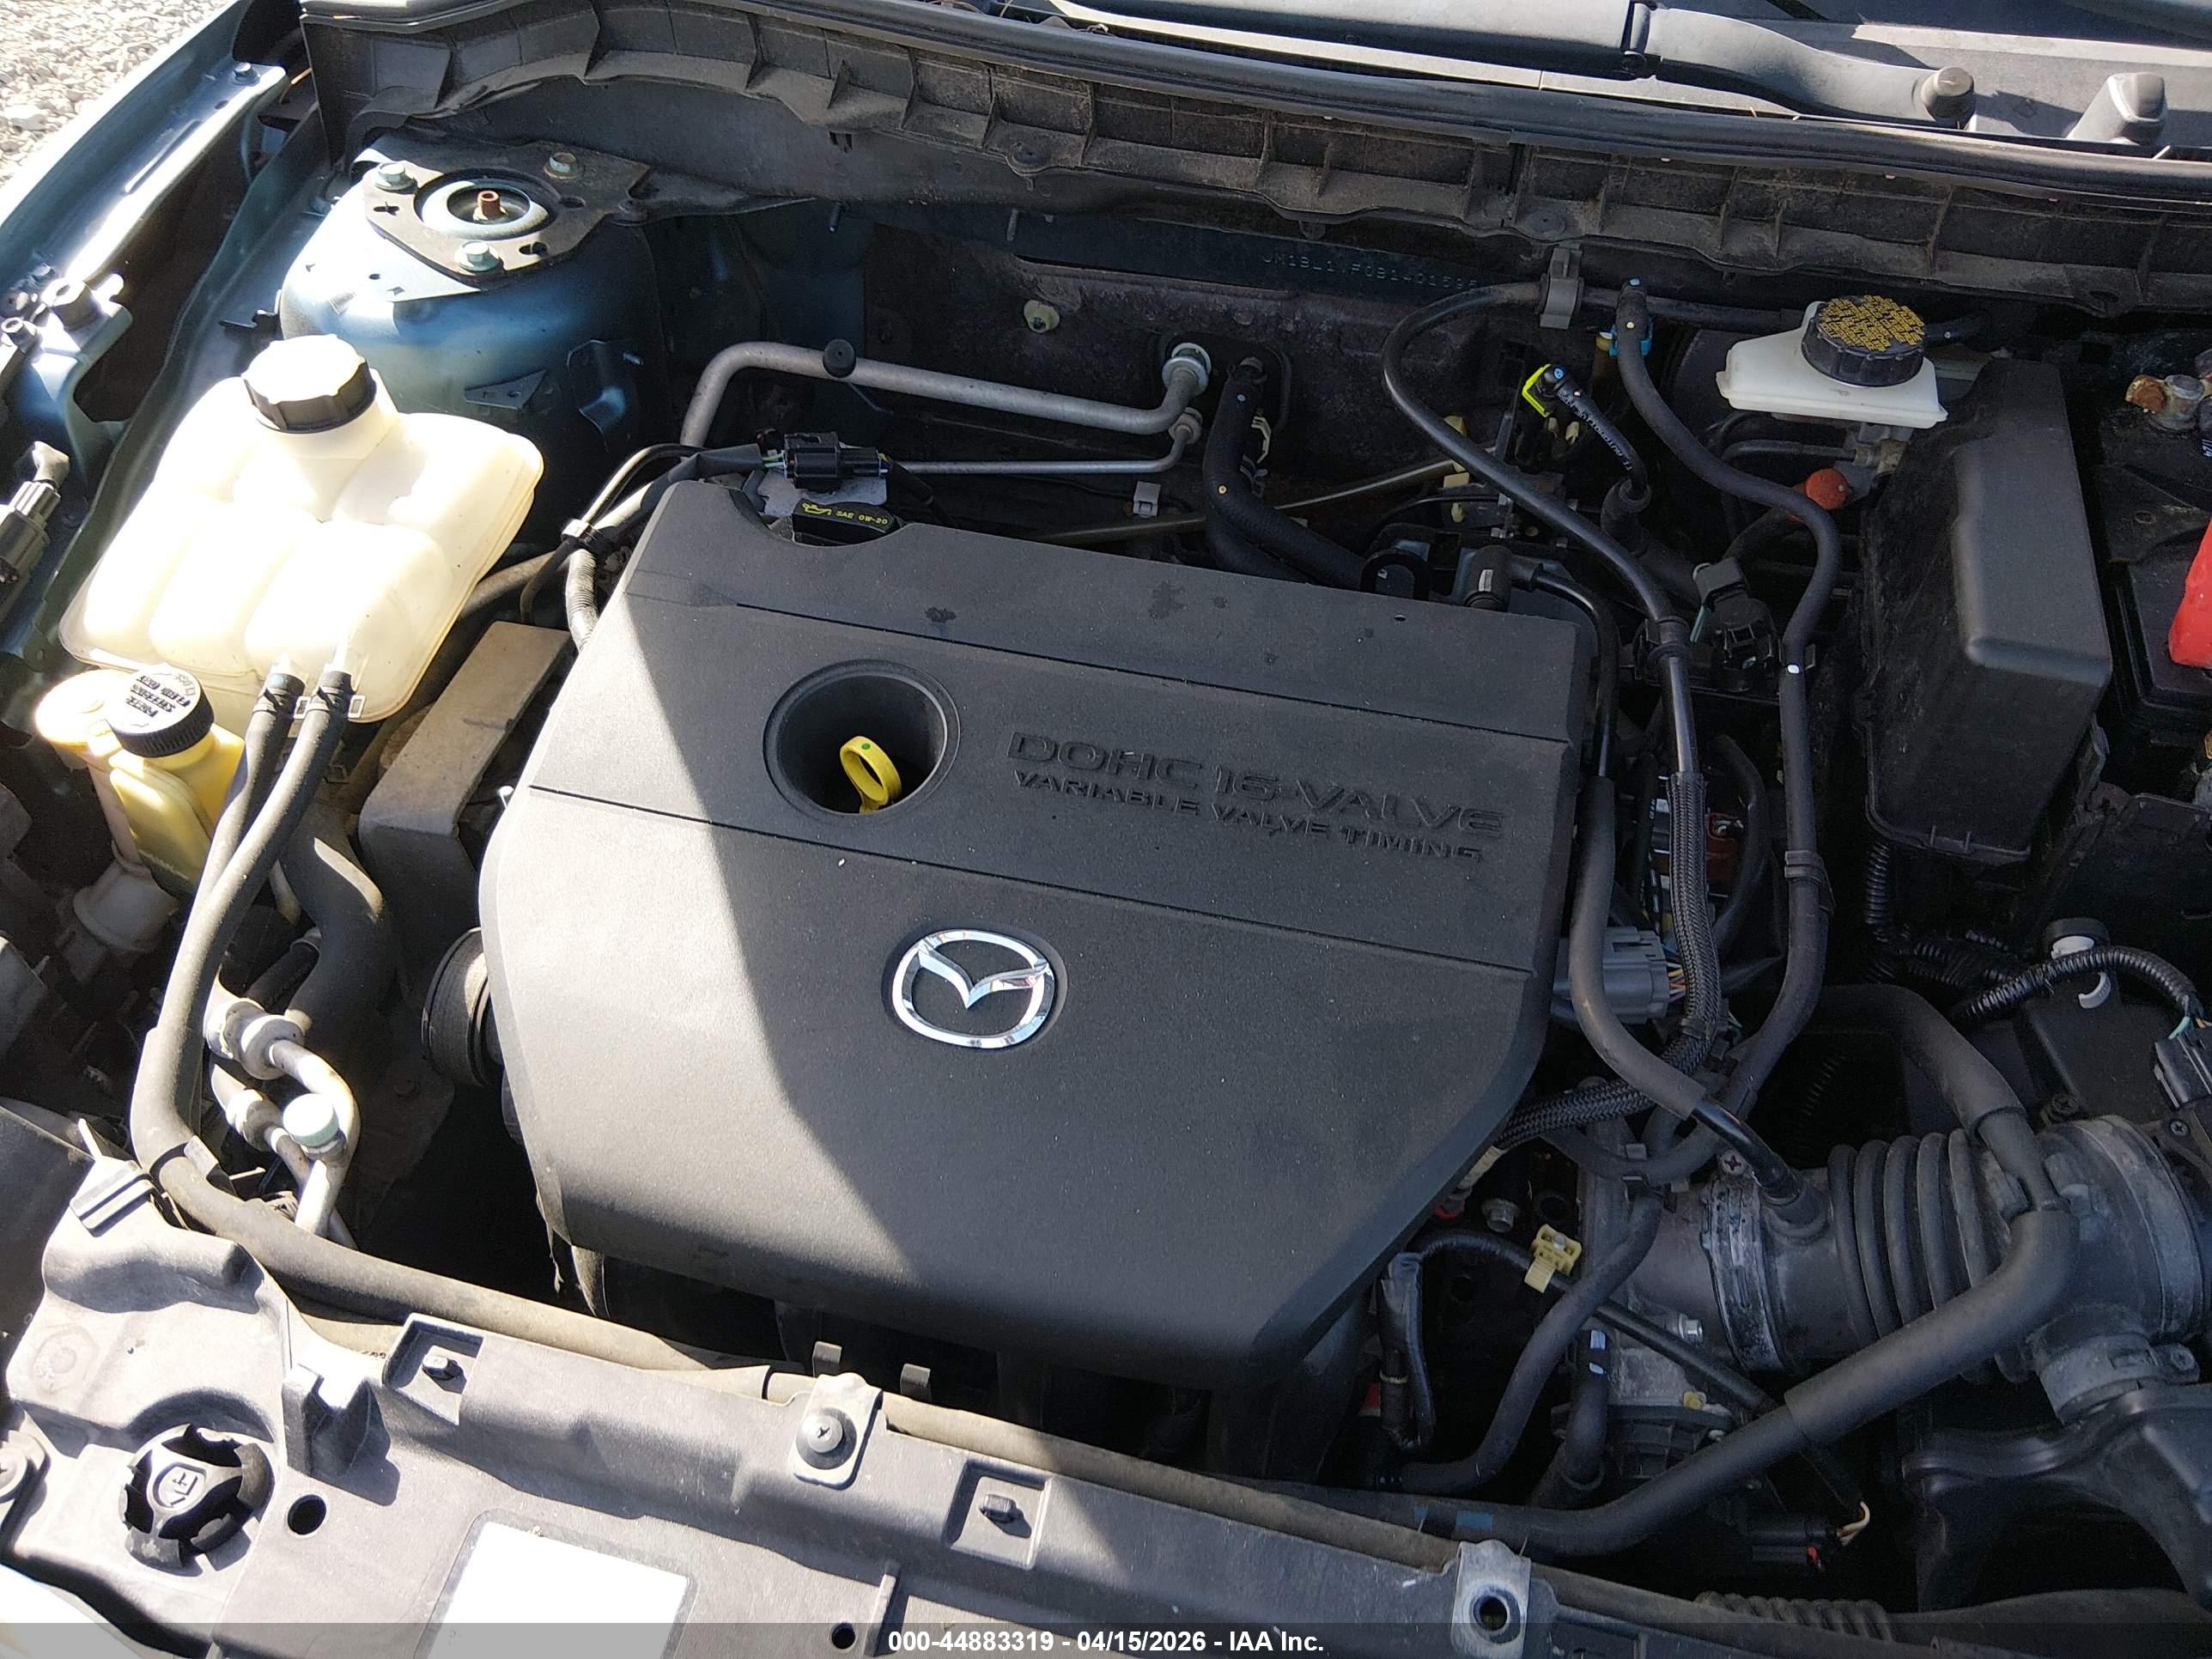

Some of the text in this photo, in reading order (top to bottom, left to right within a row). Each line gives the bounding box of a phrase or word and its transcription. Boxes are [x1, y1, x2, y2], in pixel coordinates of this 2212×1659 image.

[836, 510, 888, 525] SAE 0W-20
[1006, 731, 1203, 790] DOHC
[1012, 769, 1484, 864] VARIABLE VALVE TIMING
